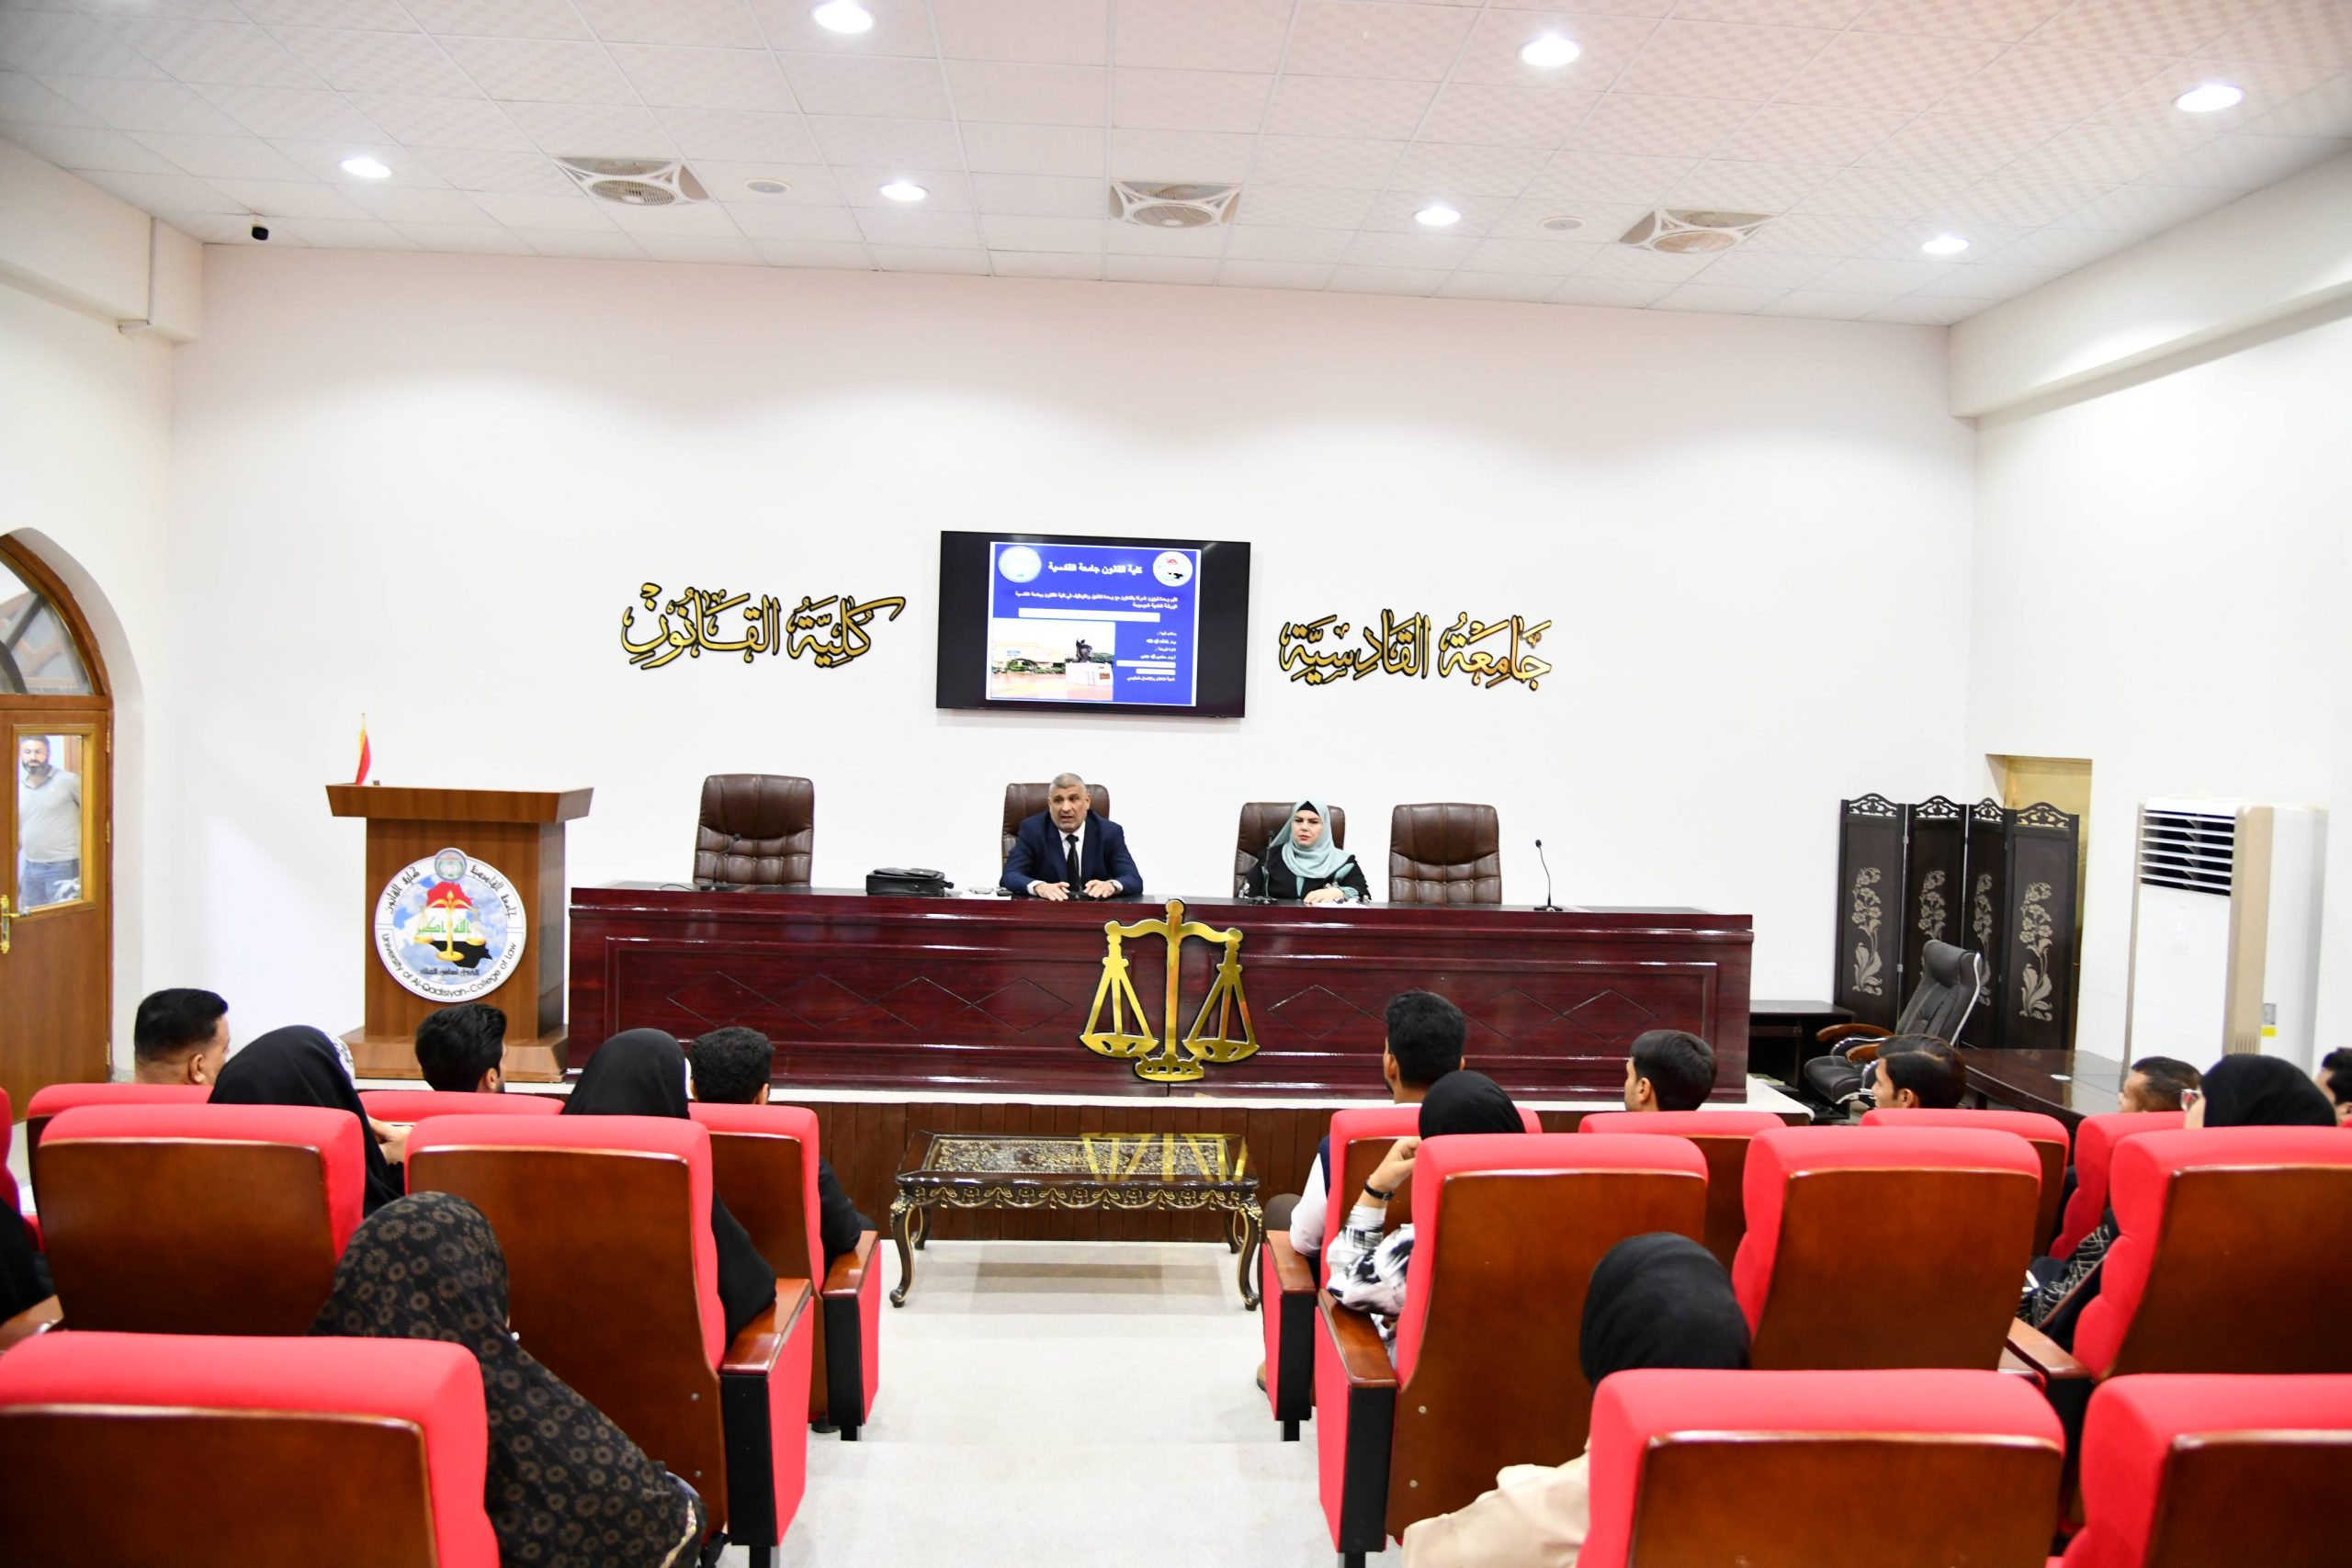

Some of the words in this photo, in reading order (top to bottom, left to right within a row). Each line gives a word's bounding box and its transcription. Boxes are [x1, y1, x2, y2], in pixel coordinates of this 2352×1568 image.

[381, 933, 404, 972] University
[403, 971, 412, 980] of
[501, 959, 509, 970] of
[505, 942, 517, 960] Law
